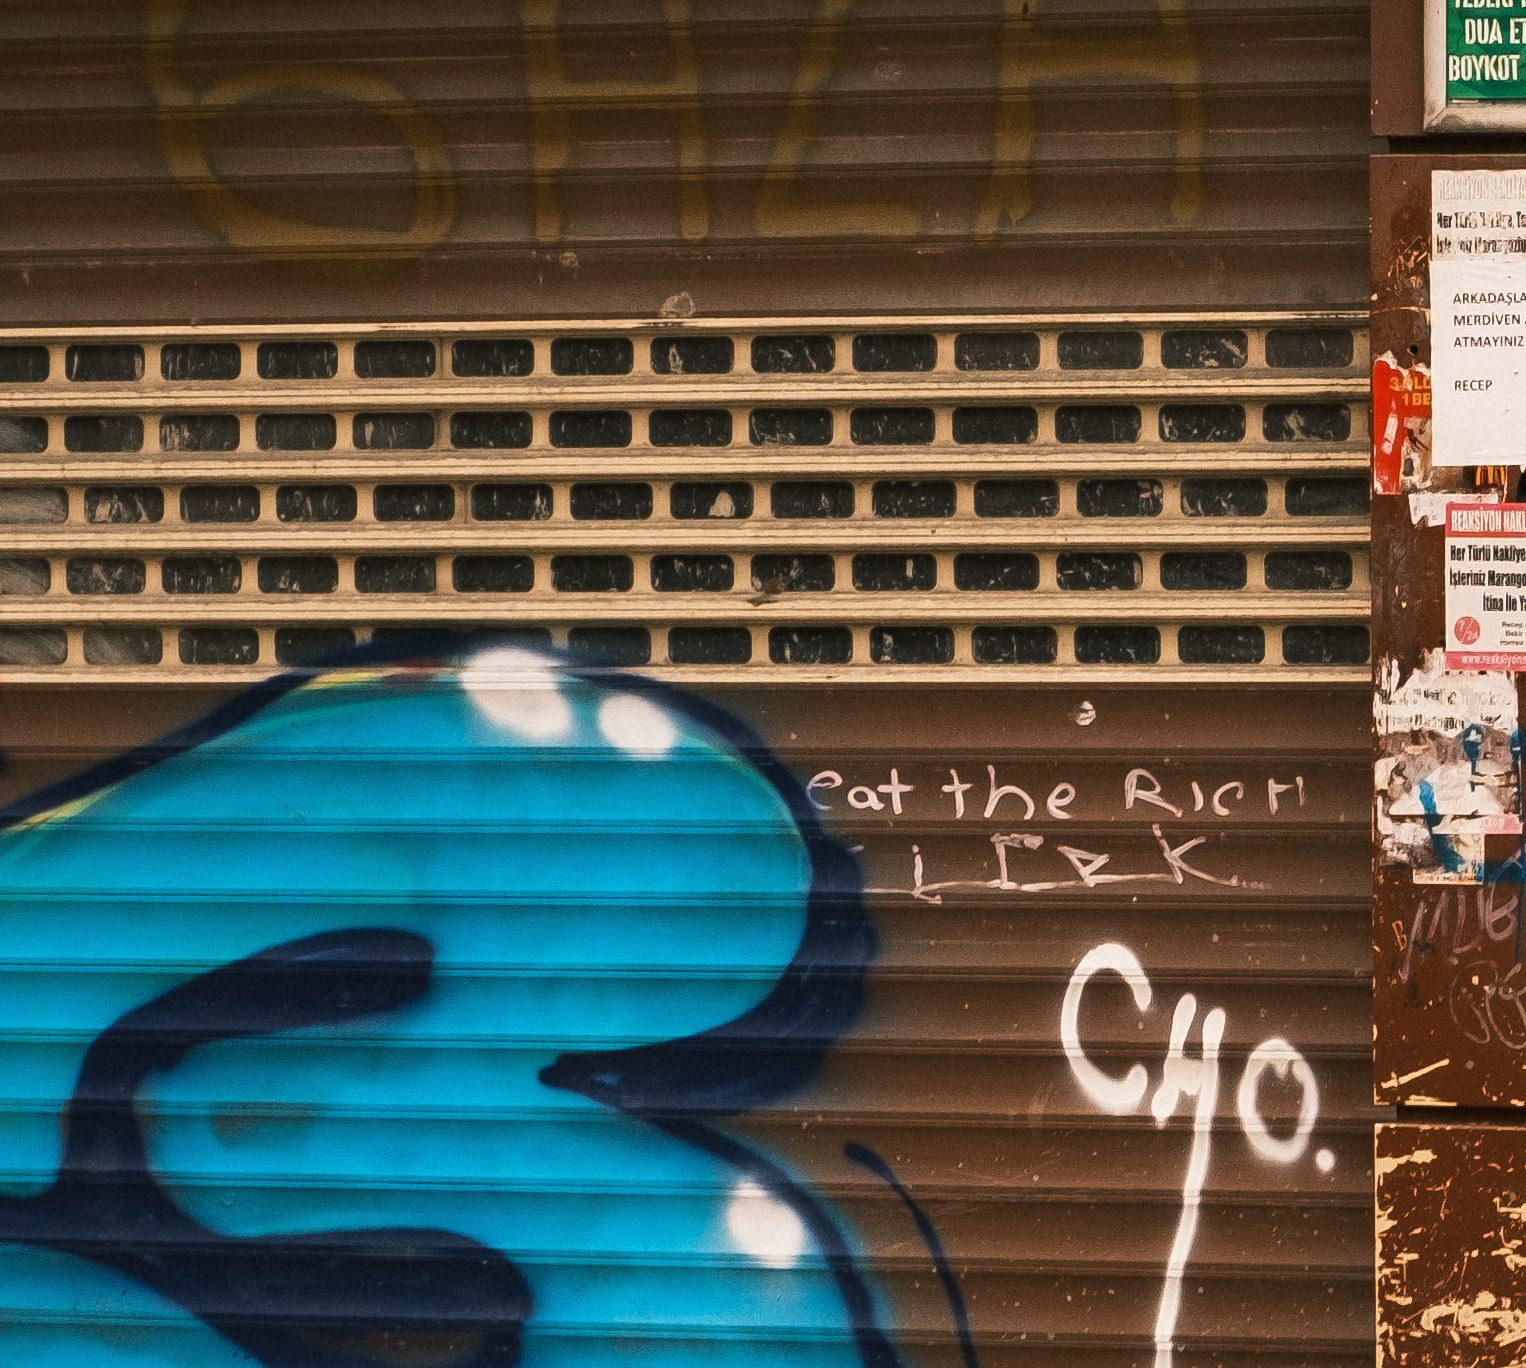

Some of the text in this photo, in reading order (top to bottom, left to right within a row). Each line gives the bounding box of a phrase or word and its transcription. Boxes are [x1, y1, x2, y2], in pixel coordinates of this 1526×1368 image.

[1464, 17, 1501, 45] DUA
[1448, 54, 1520, 82] BOYKOT
[1453, 310, 1521, 326] MERDİVEN
[1453, 335, 1525, 348] ATMAYINIZ
[1454, 379, 1493, 392] RECEP
[1451, 507, 1502, 533] REAKSİYON
[1450, 545, 1466, 562] Her
[805, 767, 914, 816] eat
[941, 764, 1077, 820] the
